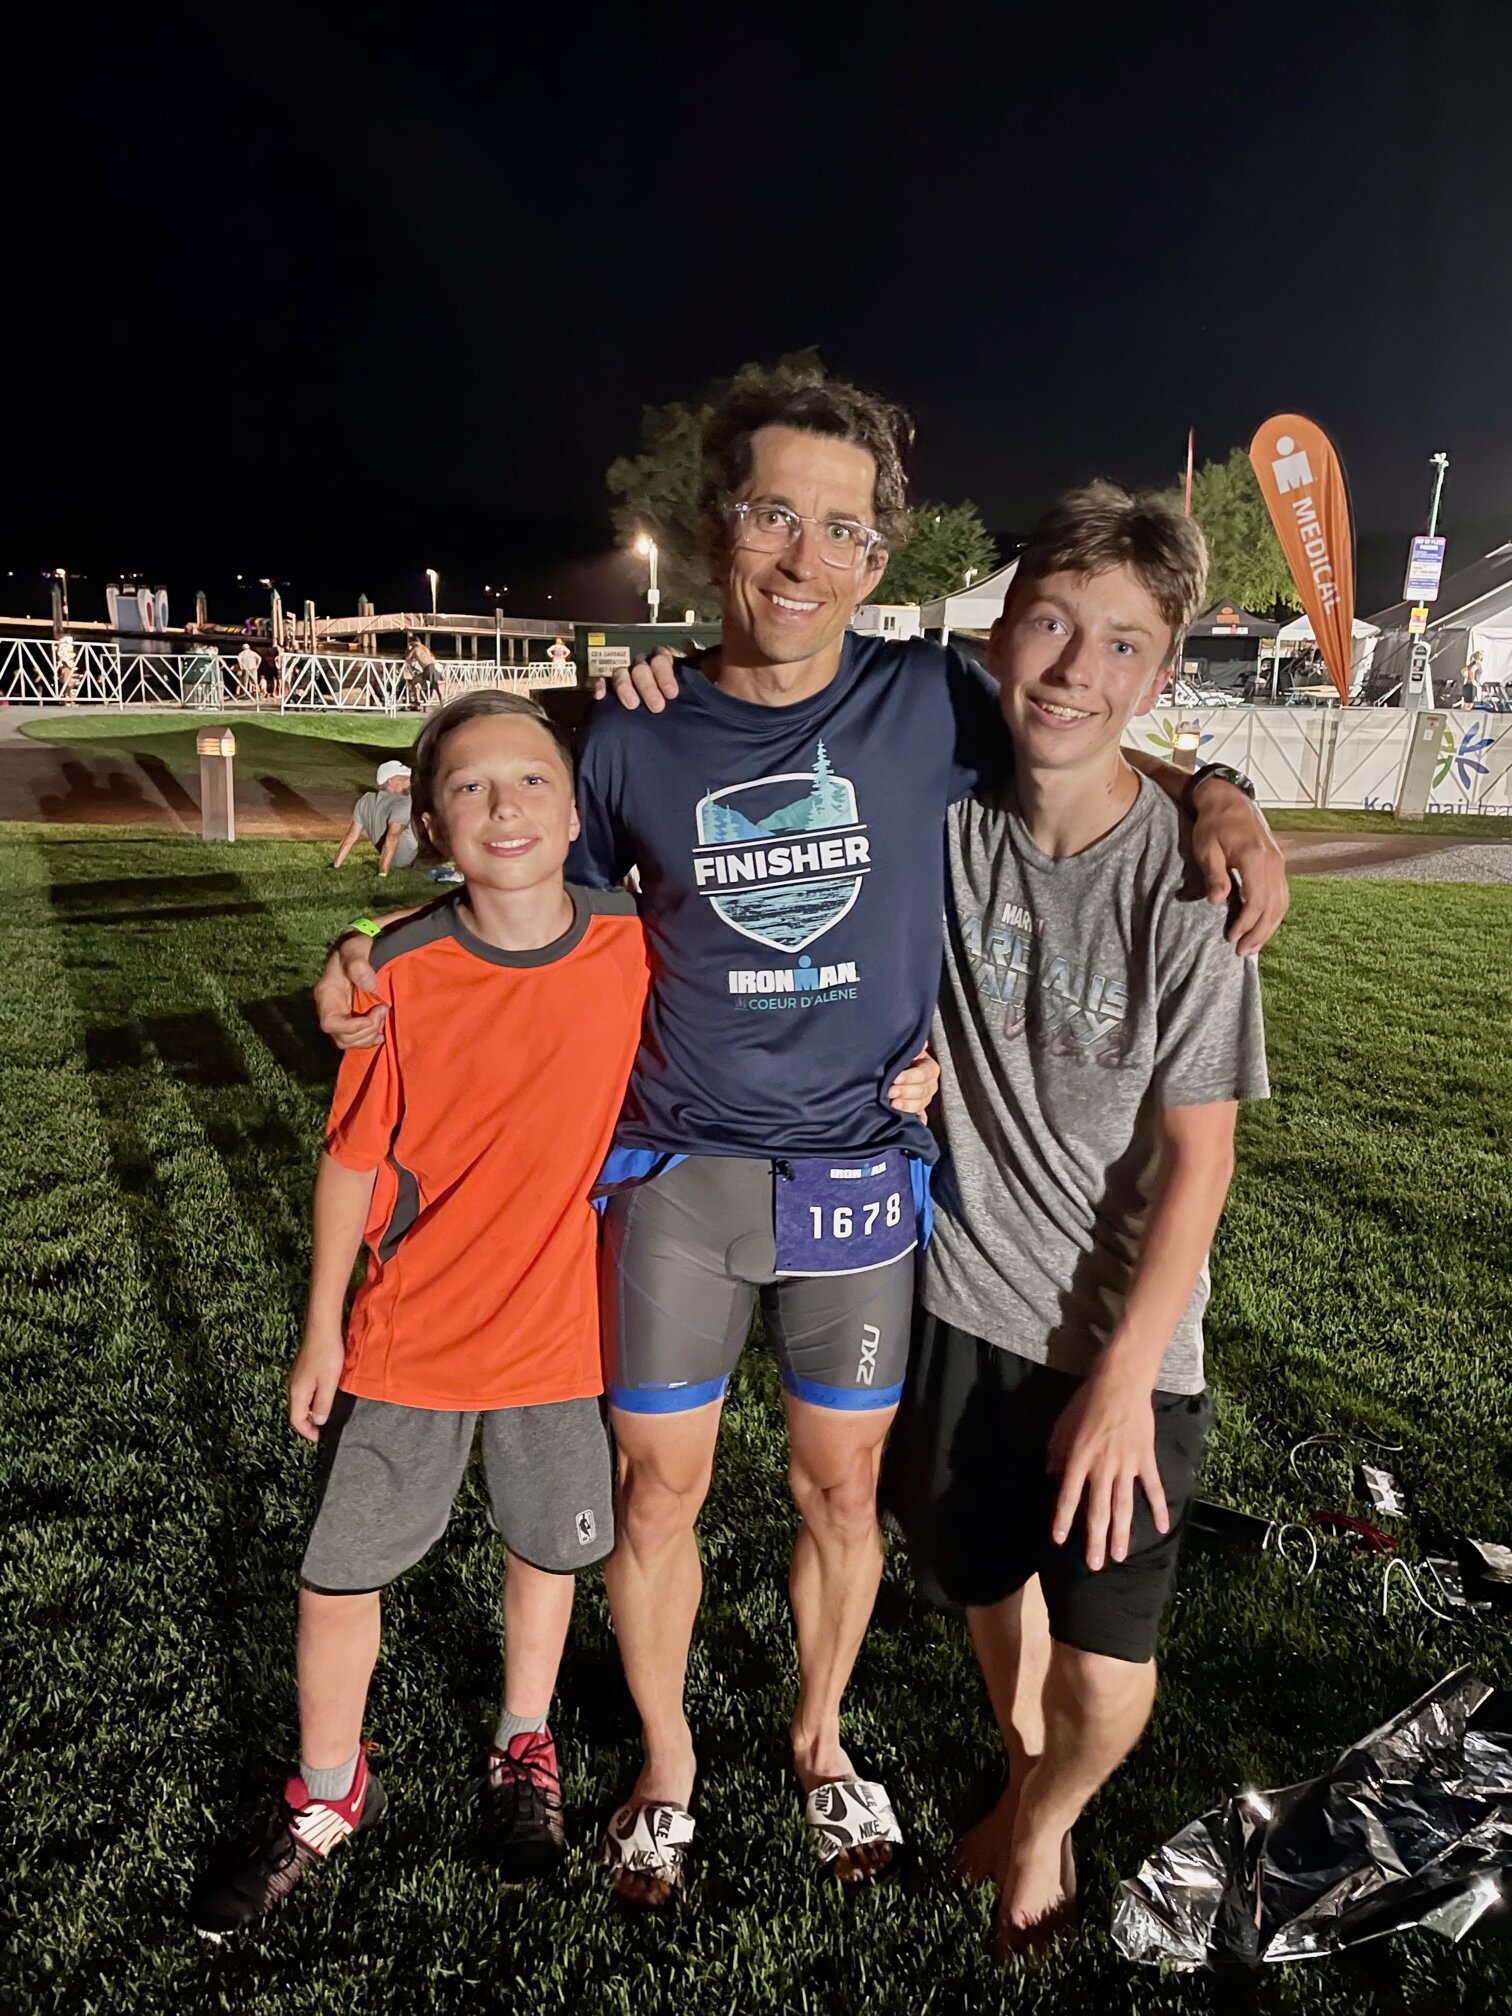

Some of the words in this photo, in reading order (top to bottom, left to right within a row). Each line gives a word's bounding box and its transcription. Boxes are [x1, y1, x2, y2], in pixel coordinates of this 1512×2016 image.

[1292, 496, 1341, 615] MEDICAL
[693, 836, 871, 886] FINISHER
[729, 955, 860, 994] IRONMAN
[748, 998, 797, 1010] COEUR
[800, 988, 858, 1008] D'ALENE
[809, 1192, 901, 1239] 1678
[856, 1323, 881, 1386] 2XU
[655, 1809, 674, 1839] NIKE
[859, 1820, 882, 1839] NIKE
